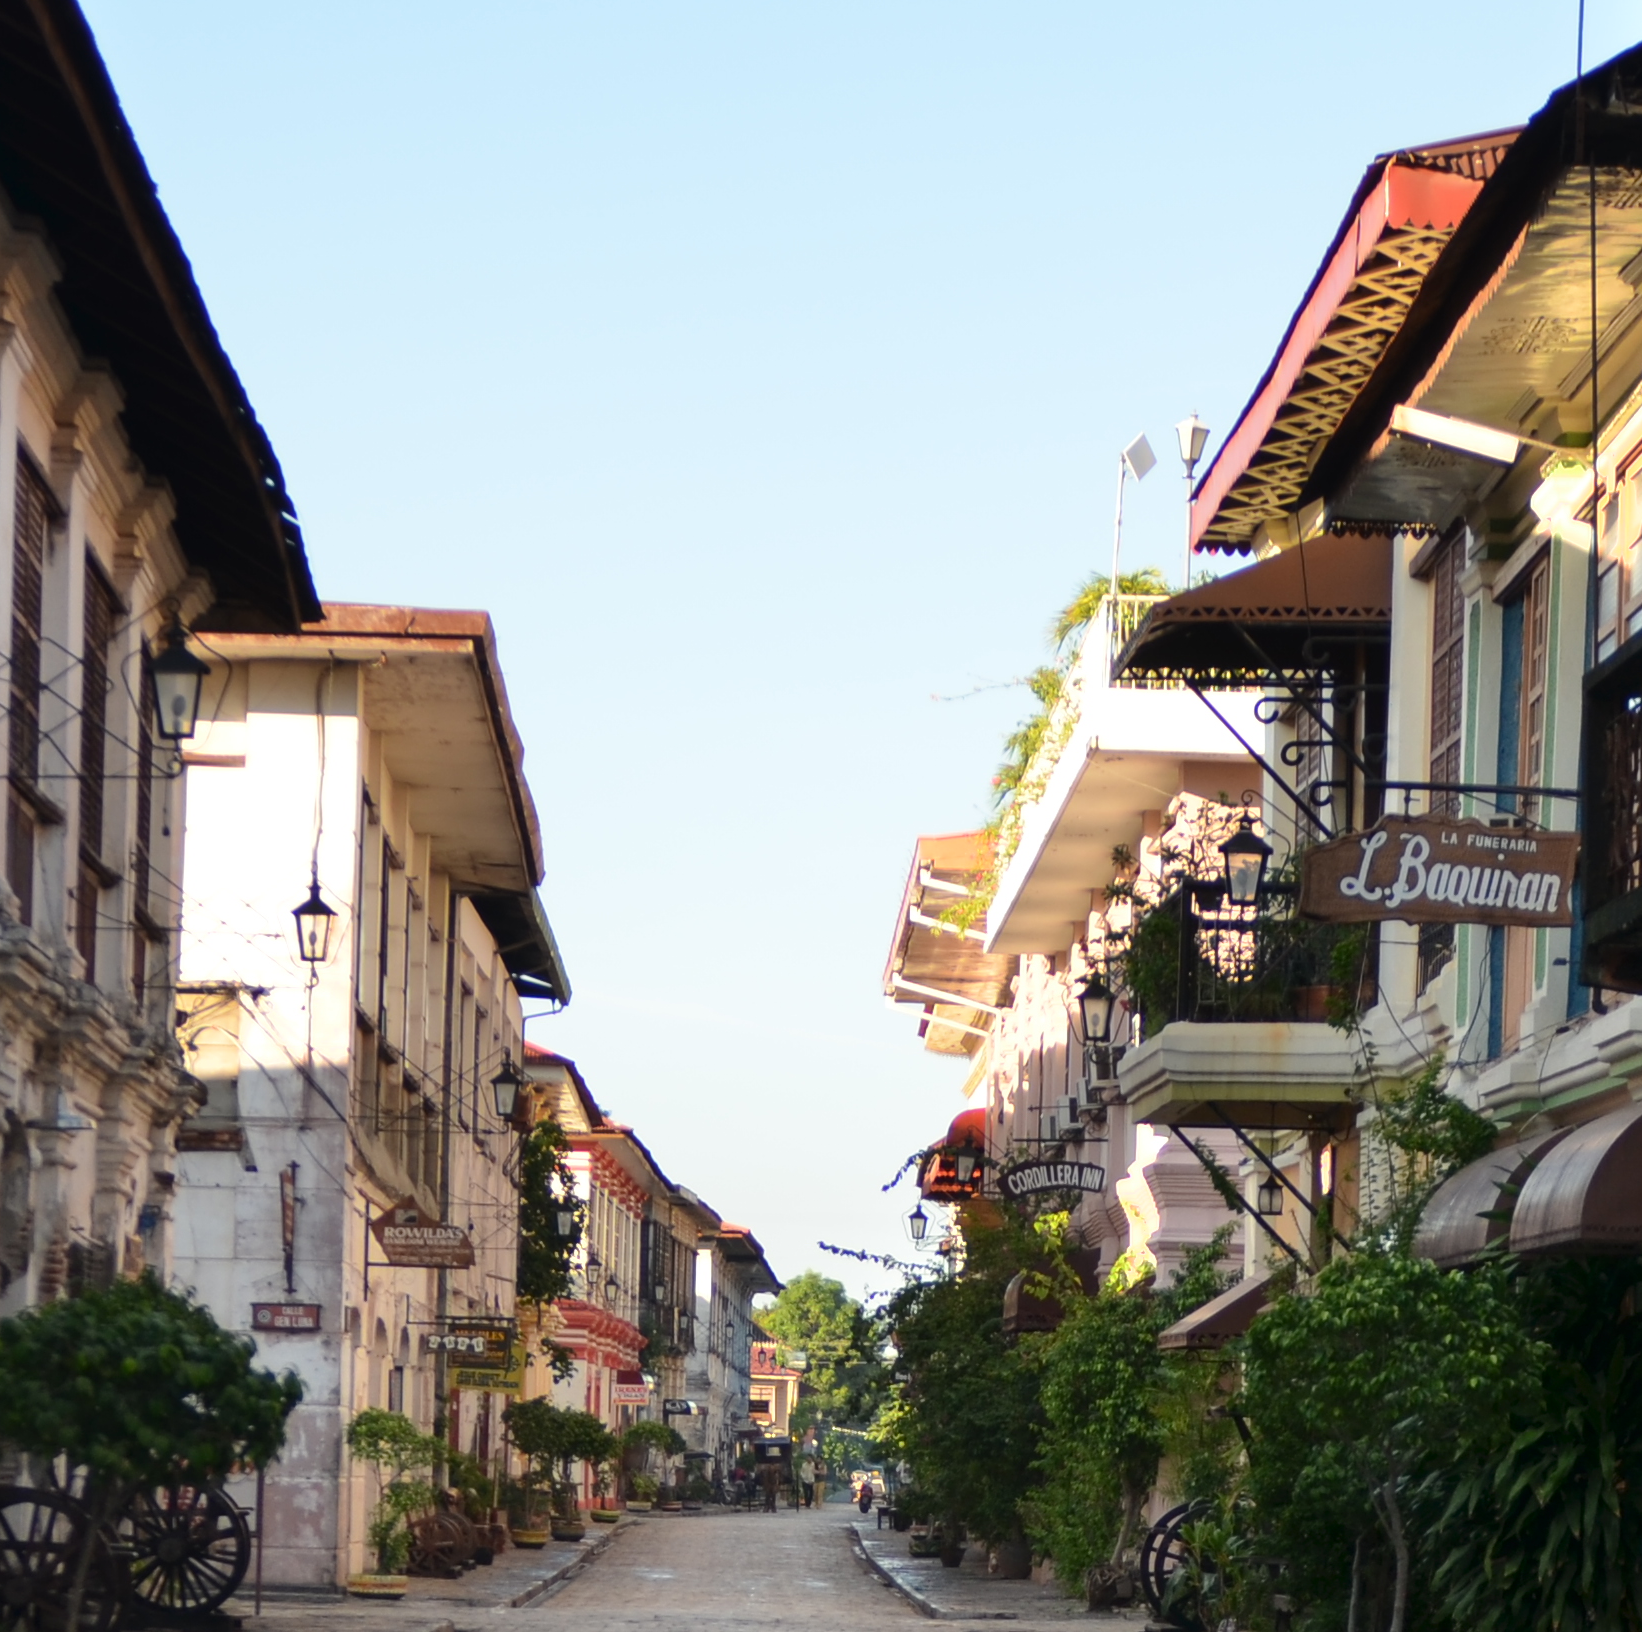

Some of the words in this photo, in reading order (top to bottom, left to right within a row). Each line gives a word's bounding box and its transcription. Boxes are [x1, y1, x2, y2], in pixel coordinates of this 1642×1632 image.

[1441, 831, 1458, 845] LA
[1467, 834, 1537, 853] FUNERARIA
[1008, 1164, 1079, 1194] CORDILLERA
[1080, 1166, 1103, 1190] INN
